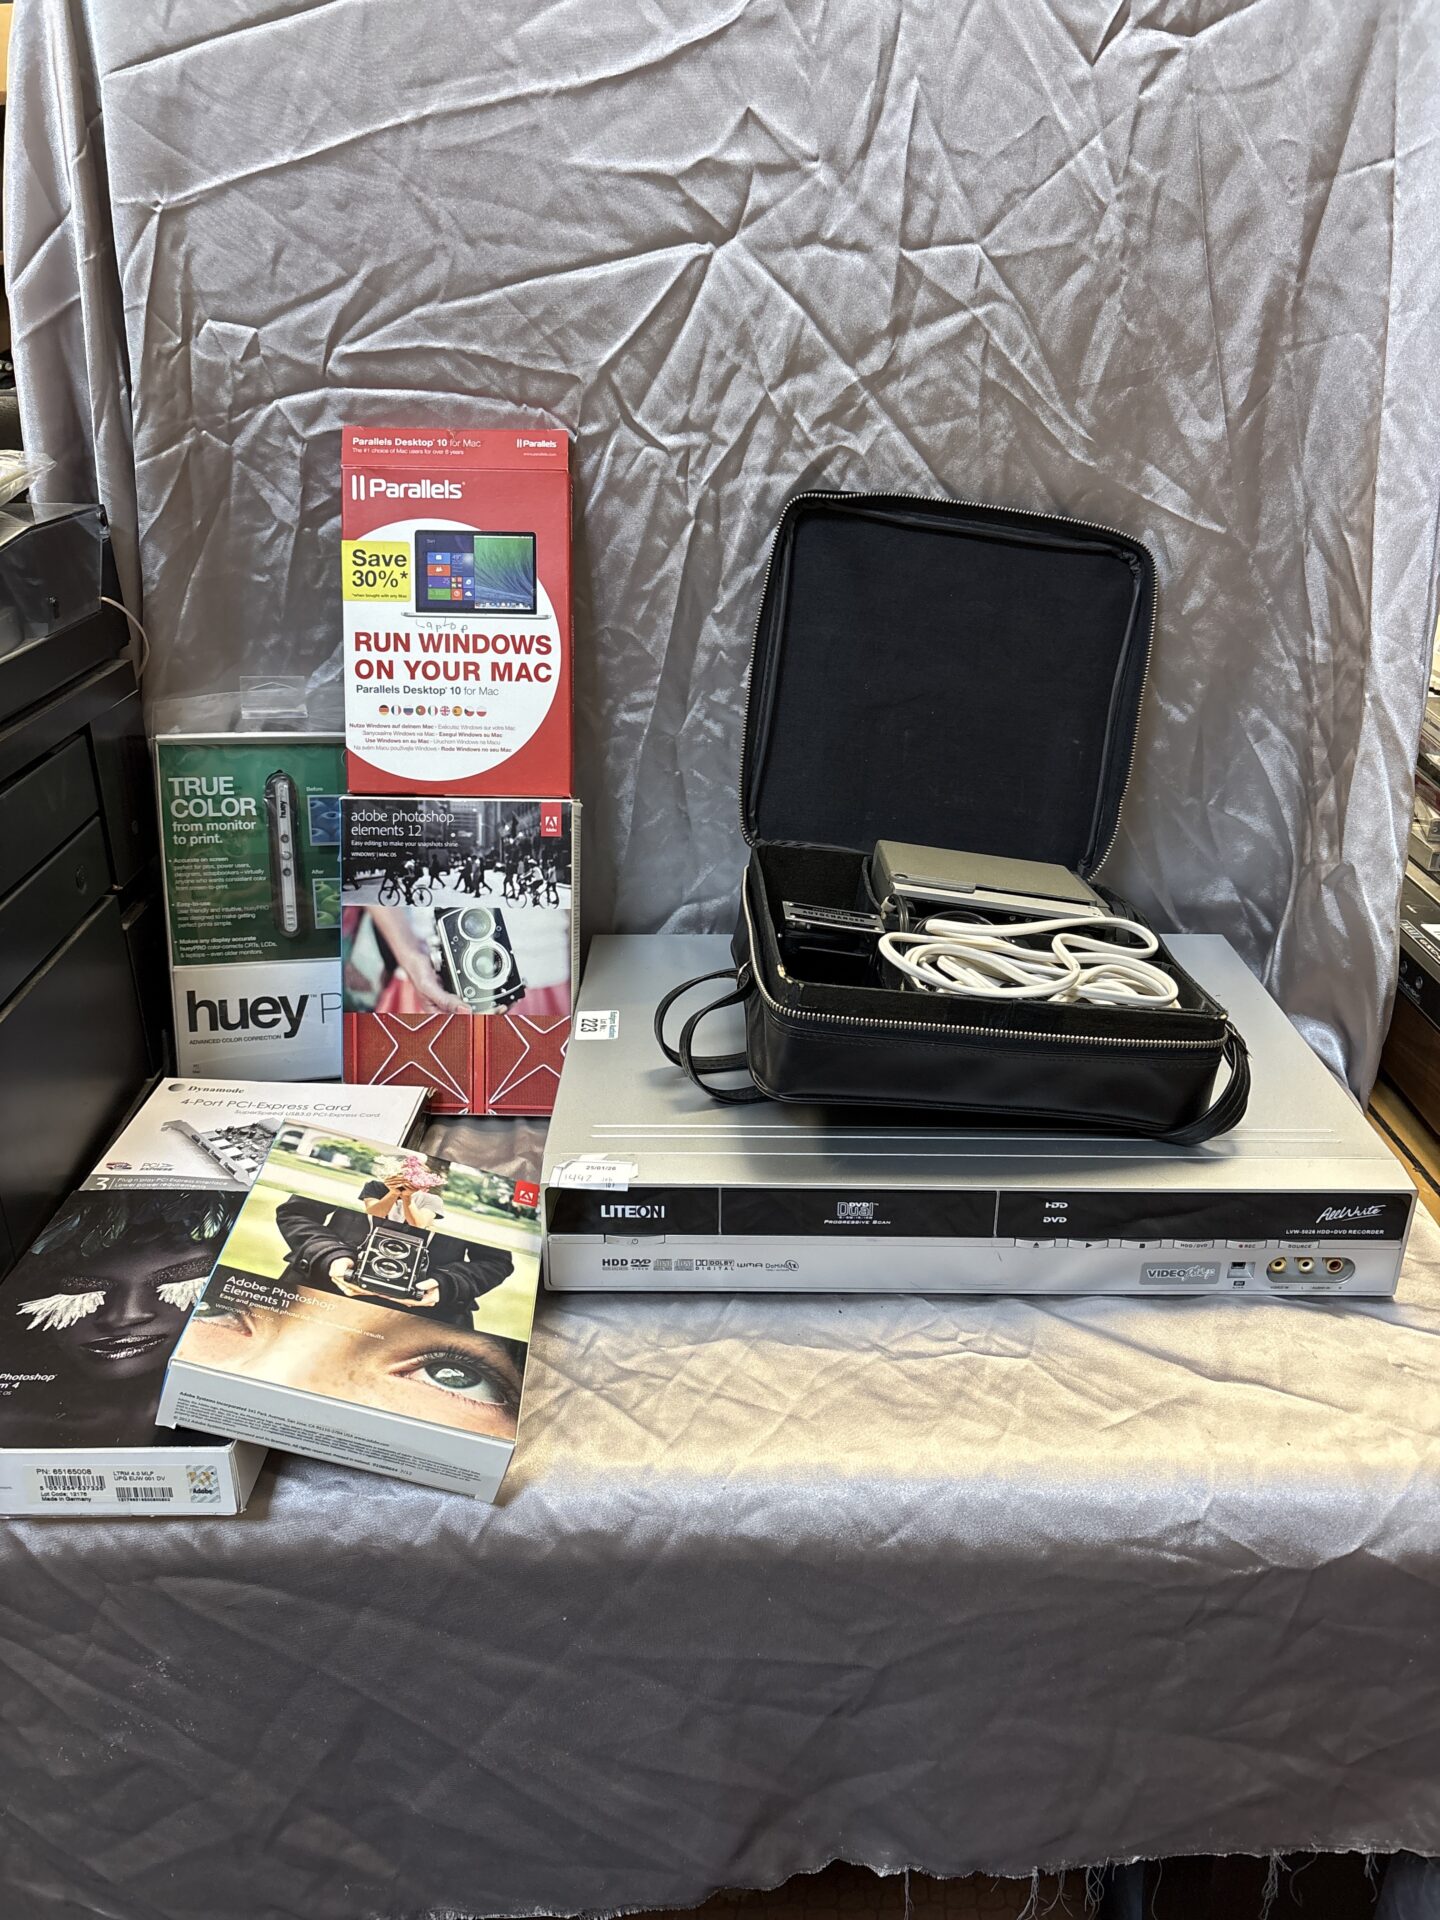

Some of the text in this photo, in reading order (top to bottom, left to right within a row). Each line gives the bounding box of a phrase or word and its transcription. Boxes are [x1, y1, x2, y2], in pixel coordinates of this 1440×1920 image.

[352, 437, 481, 448] Parallels Desktop 10 for Mac
[522, 439, 557, 448] Parallels
[368, 477, 463, 500] Parallels
[351, 549, 408, 568] Save
[354, 631, 553, 656] RUN WINDOWS
[354, 659, 553, 684] ON YOUR MAC
[356, 684, 500, 698] Parallels Desktop 10 for Mac
[168, 776, 235, 796] TRUE
[170, 797, 258, 818] COLOR
[351, 810, 455, 826] adobe photoshop
[172, 820, 257, 833] from monitor
[351, 824, 423, 837] elements 12
[173, 832, 223, 846] to print.
[351, 839, 363, 848] Easy
[363, 840, 382, 848] editing
[418, 841, 447, 850] snapshots
[186, 990, 310, 1039] huey
[580, 1018, 599, 1033] 223
[243, 1034, 282, 1043] CORRECTION
[187, 1084, 246, 1095] Dynamode
[180, 1097, 353, 1114] 4-Port PCI-Express Card
[600, 1204, 665, 1219] LITEON
[837, 1201, 874, 1217] Dual
[1044, 1201, 1069, 1209] HDD
[1042, 1216, 1068, 1224] DVD
[1315, 1204, 1387, 1225] AllWrite
[601, 1258, 628, 1267] HDD
[630, 1258, 652, 1266] DVD
[222, 1284, 291, 1309] Elements 11
[226, 1275, 336, 1311] Adobe Photoshop
[218, 1292, 236, 1303] Easy
[235, 1297, 249, 1306] and
[249, 1300, 279, 1315] powerful
[0, 1372, 56, 1384] Photoshop
[11, 1381, 21, 1389] 4
